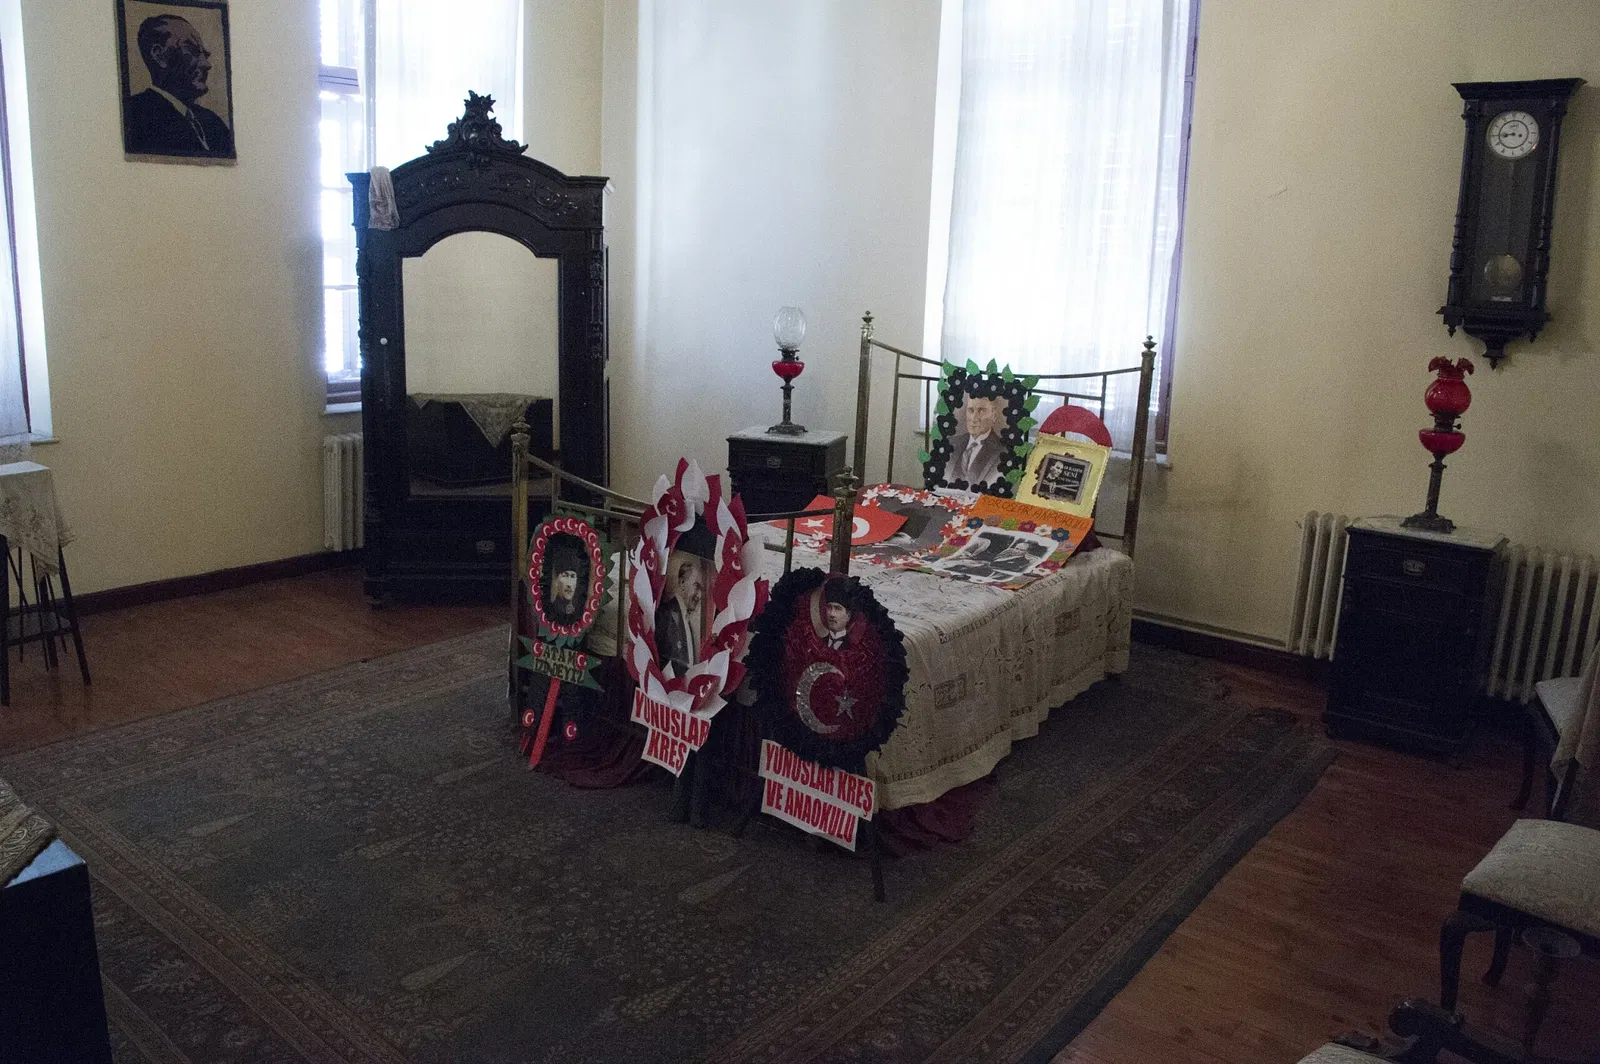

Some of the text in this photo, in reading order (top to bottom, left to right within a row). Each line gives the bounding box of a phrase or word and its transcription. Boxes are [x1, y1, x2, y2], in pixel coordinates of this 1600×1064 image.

[635, 690, 709, 748] YUNUSLAR
[766, 743, 873, 817] YUNUSLAR KREŞ
[766, 778, 856, 843] VE ANAOKULU
